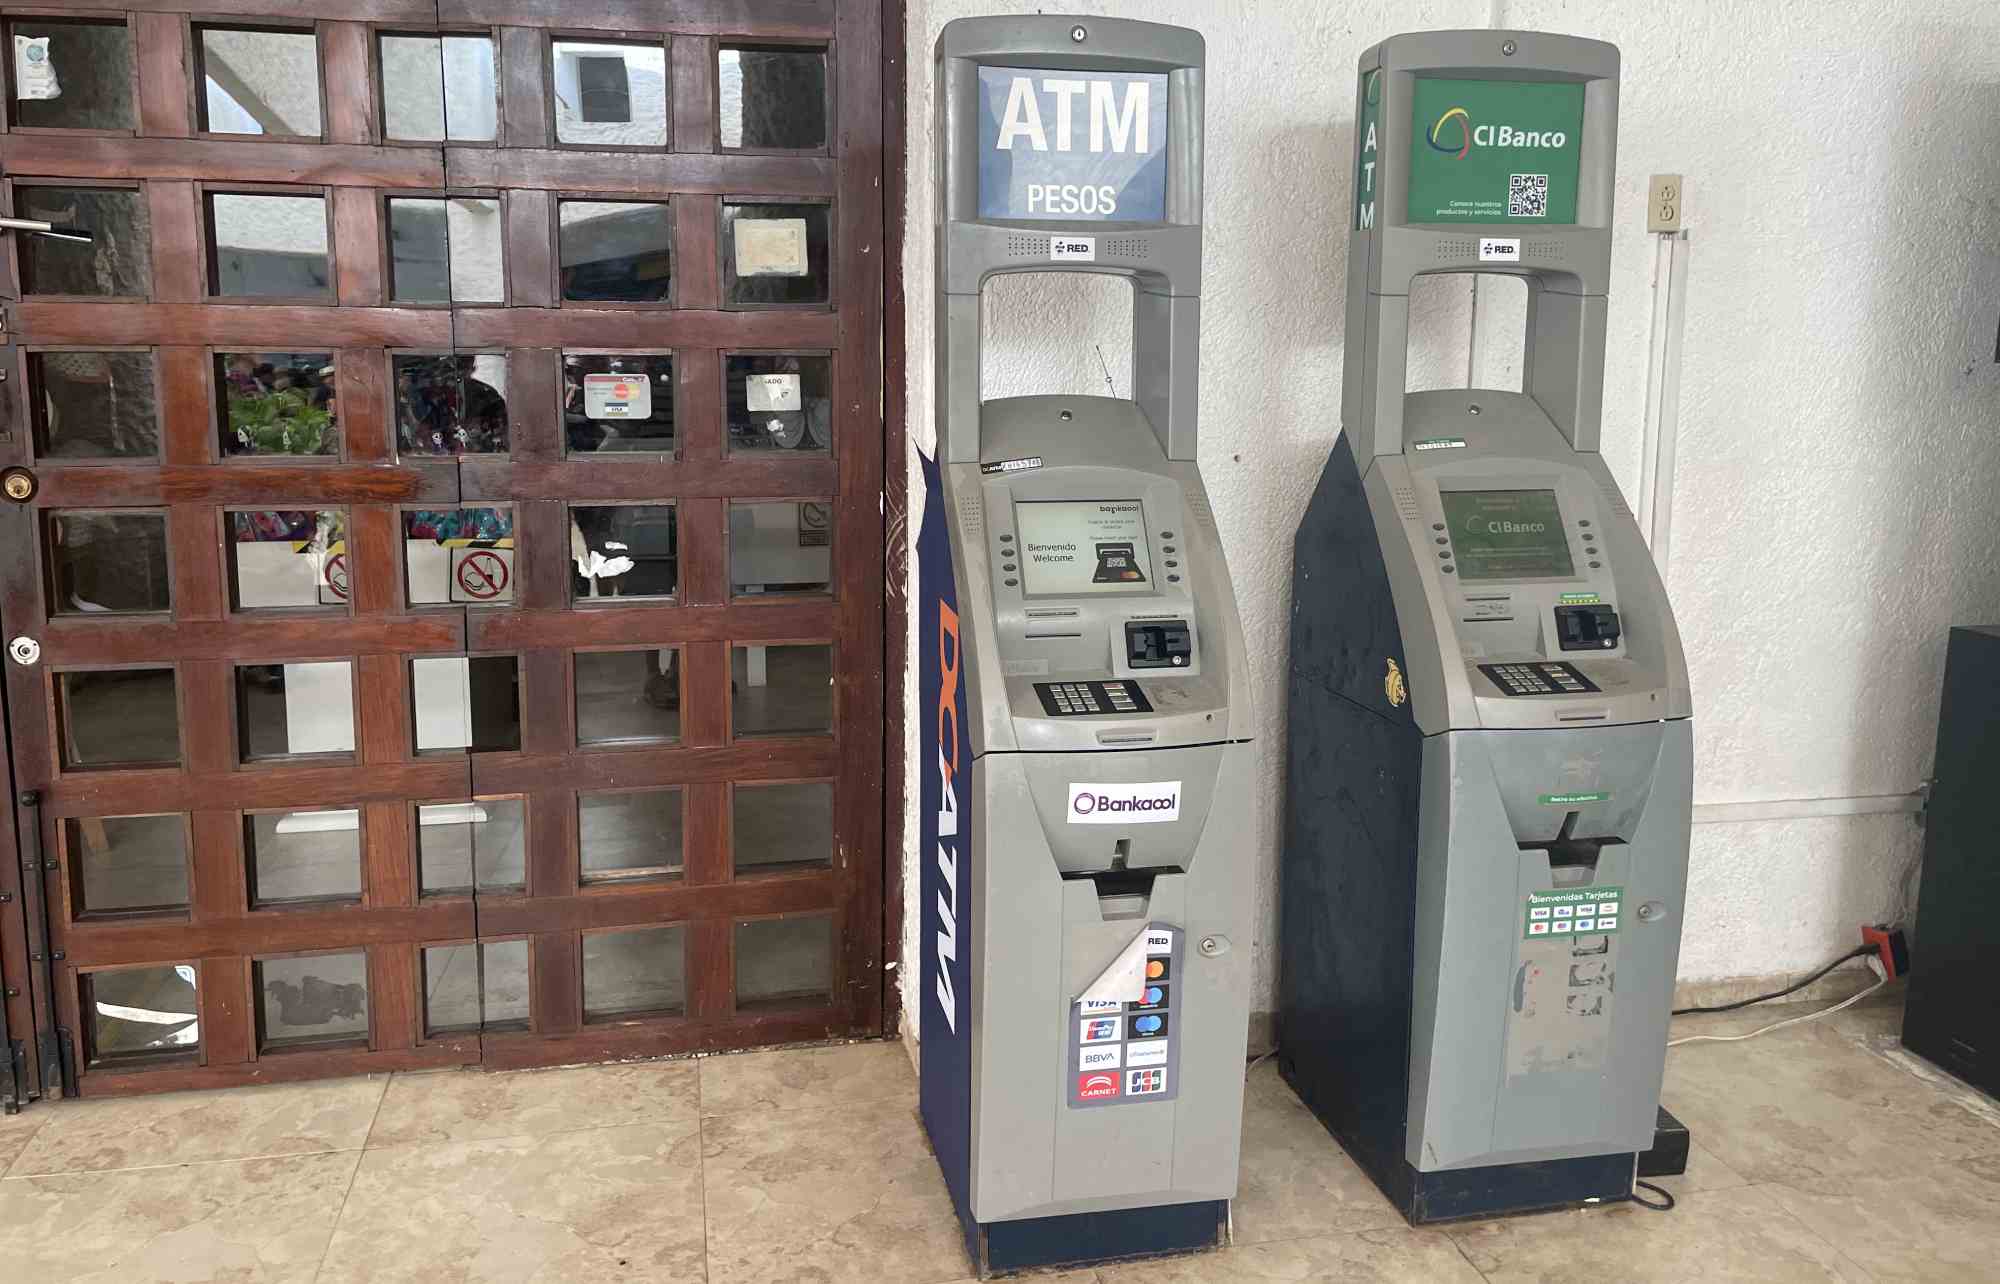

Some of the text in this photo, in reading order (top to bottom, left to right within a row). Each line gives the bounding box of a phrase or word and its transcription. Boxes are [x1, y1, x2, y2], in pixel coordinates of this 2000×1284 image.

[996, 77, 1150, 154] ATM
[1359, 121, 1377, 231] ATM
[1028, 184, 1117, 215] PESOS
[1066, 243, 1089, 254] RED
[1494, 245, 1515, 254] RED
[1027, 543, 1077, 552] Bienvenido
[1033, 554, 1074, 562] Welcome
[1098, 794, 1176, 812] Bankaool
[1585, 891, 1618, 900] Tarjetas
[1148, 937, 1168, 945] RED
[1085, 1053, 1115, 1063] BBVA
[1081, 1088, 1118, 1097] CARNET
